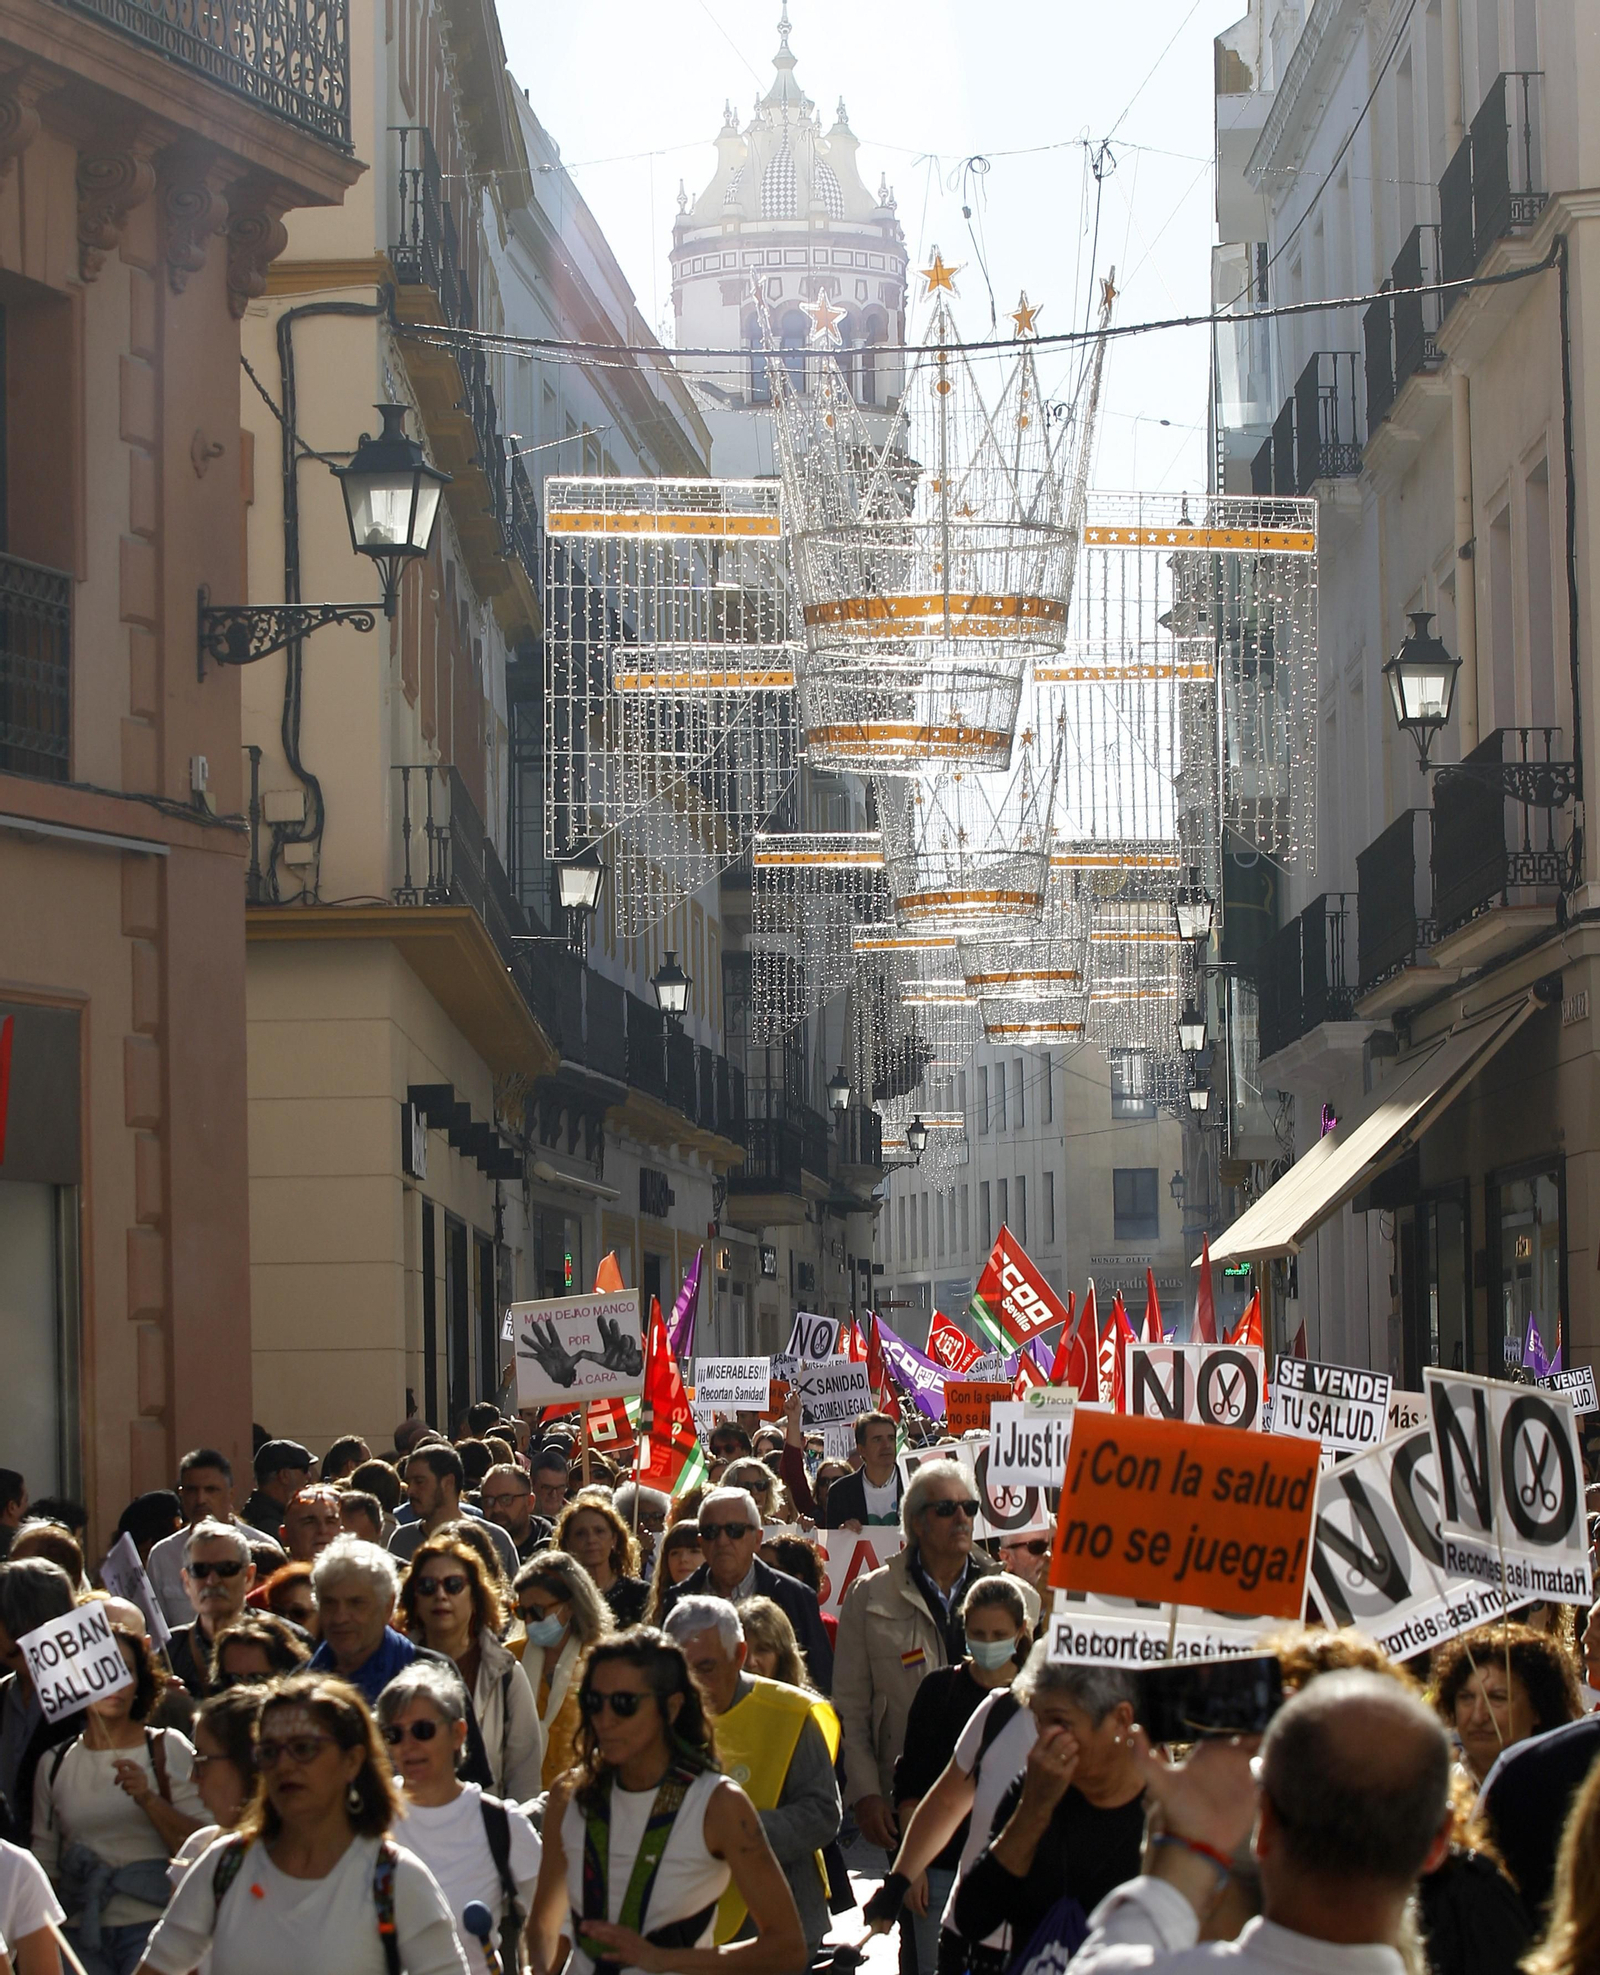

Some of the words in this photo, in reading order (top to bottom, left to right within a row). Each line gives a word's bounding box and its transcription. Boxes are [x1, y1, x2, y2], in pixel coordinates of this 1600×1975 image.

[593, 1302, 635, 1317] MANCO
[1001, 1296, 1031, 1333] Sevilla
[569, 1335, 590, 1346] POR
[789, 1317, 833, 1359] NO
[585, 1372, 617, 1385] CARA
[697, 1365, 768, 1382] ¡¡¡MISERABLES!!!
[816, 1373, 869, 1395] SANIDAD,
[1279, 1360, 1306, 1389] SE
[1313, 1366, 1388, 1404] VENDE
[1538, 1378, 1551, 1390] SE
[1553, 1368, 1591, 1389] VENDE
[697, 1386, 734, 1403] ¡Recortan
[734, 1386, 767, 1401] Sanidad!
[973, 1390, 982, 1405] la
[1046, 1395, 1074, 1405] facua
[1132, 1350, 1259, 1430] NO
[813, 1400, 844, 1420] CRIMEN
[845, 1397, 873, 1416] LEGAL!
[949, 1412, 961, 1425] no
[966, 1413, 978, 1426] se
[1281, 1394, 1304, 1429] TU
[1307, 1401, 1378, 1442] SALUD.
[1070, 1439, 1162, 1496] ¡Con
[1170, 1449, 1203, 1497] la
[1212, 1461, 1315, 1512] salud
[1429, 1380, 1578, 1547] NO
[1062, 1519, 1113, 1559] no
[1123, 1527, 1171, 1566] se
[1173, 1524, 1305, 1591] juega!
[1446, 1542, 1502, 1582] Recortes
[1506, 1560, 1529, 1589] así
[1445, 1591, 1478, 1629] así
[41, 1651, 127, 1715] SALUD!
